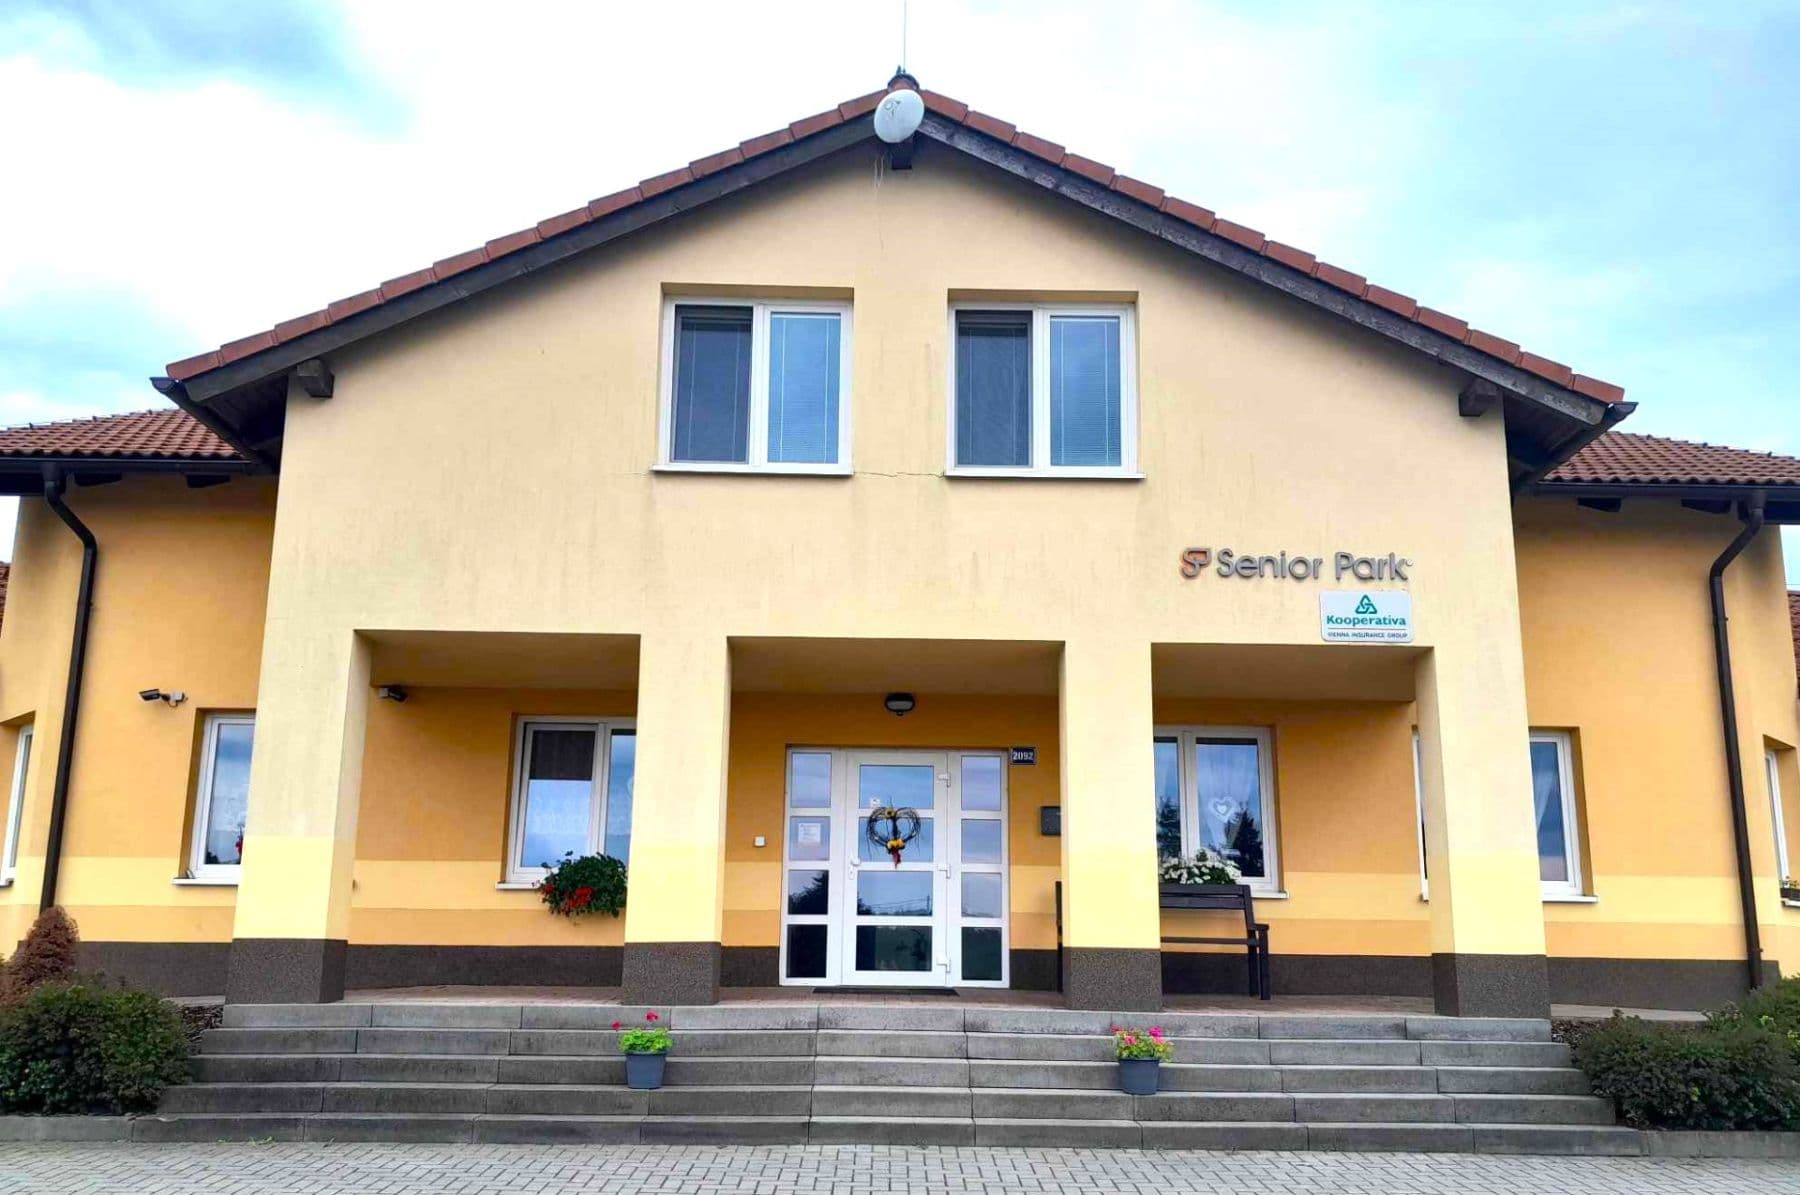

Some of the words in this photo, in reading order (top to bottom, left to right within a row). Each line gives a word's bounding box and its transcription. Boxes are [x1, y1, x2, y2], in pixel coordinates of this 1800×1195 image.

[1217, 548, 1323, 580] Senior
[1335, 551, 1409, 581] Park
[1327, 615, 1406, 627] Kooperativa
[1012, 751, 1034, 760] 2092
